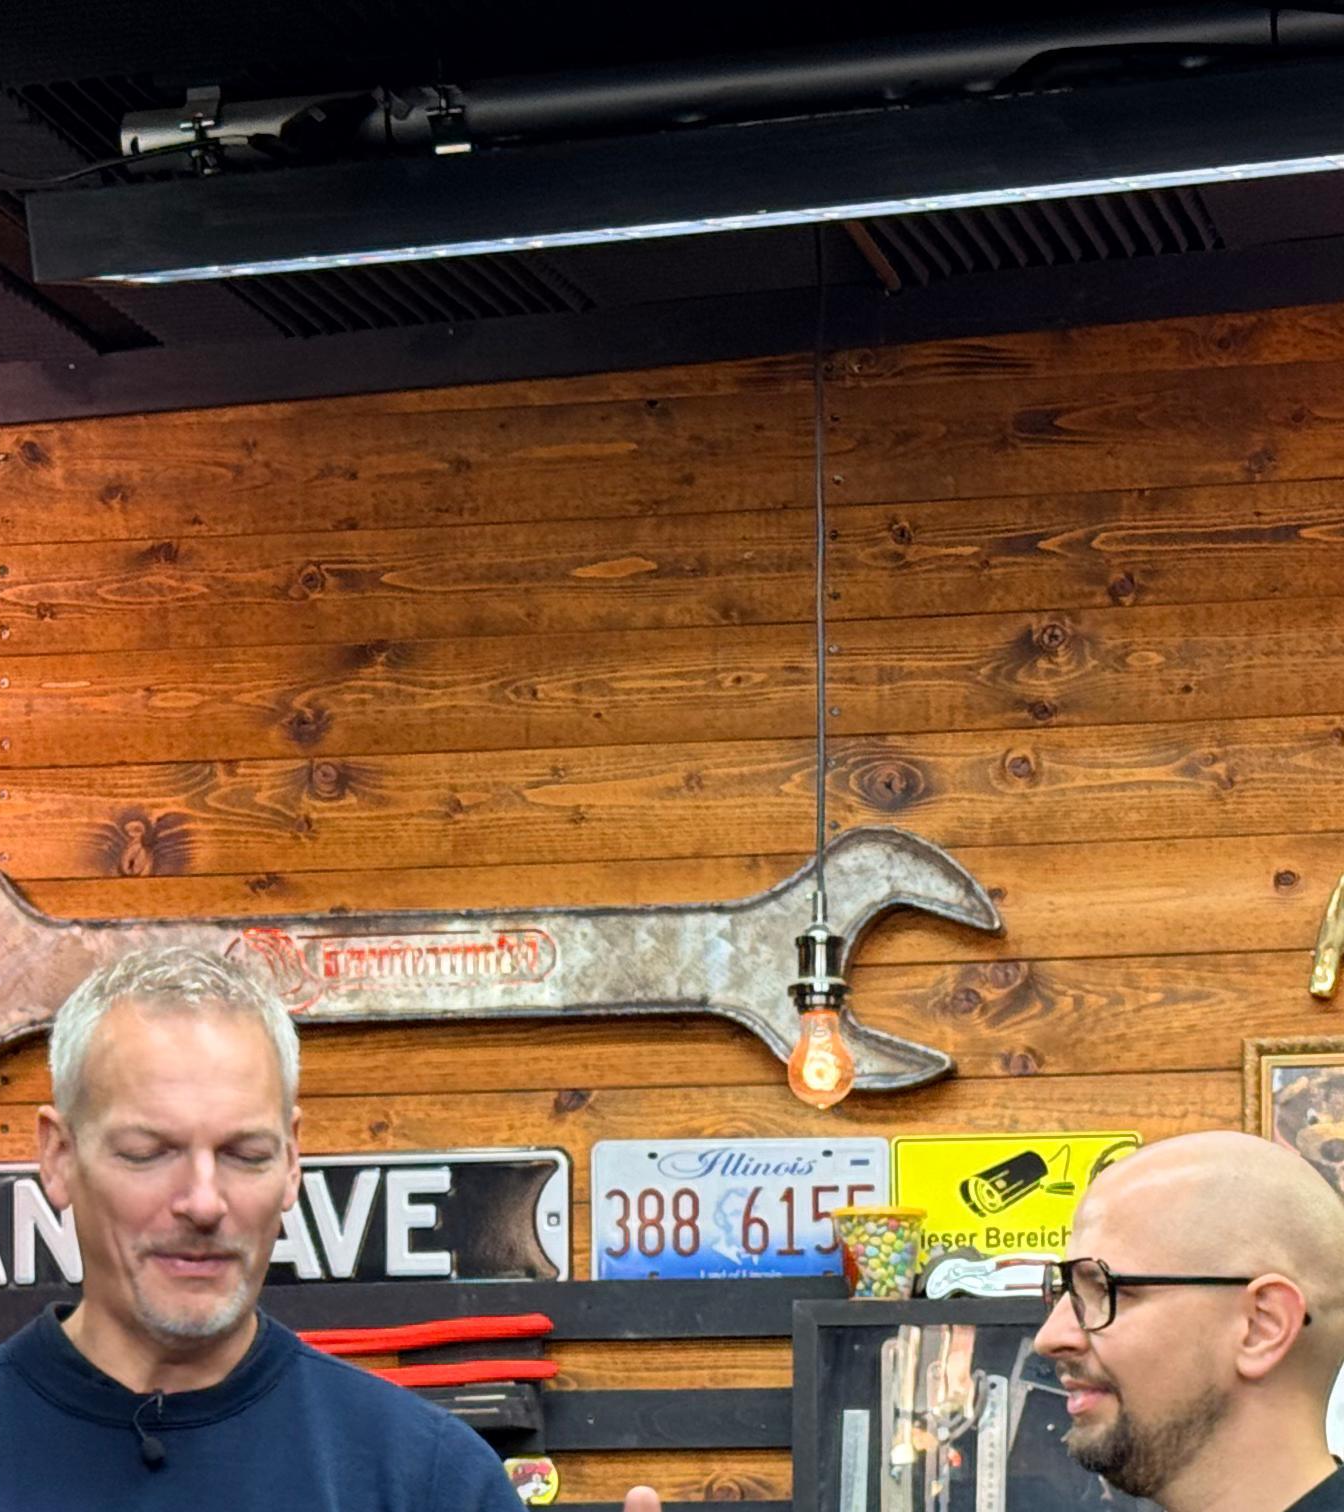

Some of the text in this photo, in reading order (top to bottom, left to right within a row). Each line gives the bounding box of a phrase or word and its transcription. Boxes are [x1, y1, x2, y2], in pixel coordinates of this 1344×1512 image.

[657, 1147, 817, 1179] Illinois
[269, 1167, 454, 1280] AVE
[605, 1185, 875, 1258] 388 615
[919, 1226, 1074, 1250] ieser Bereich
